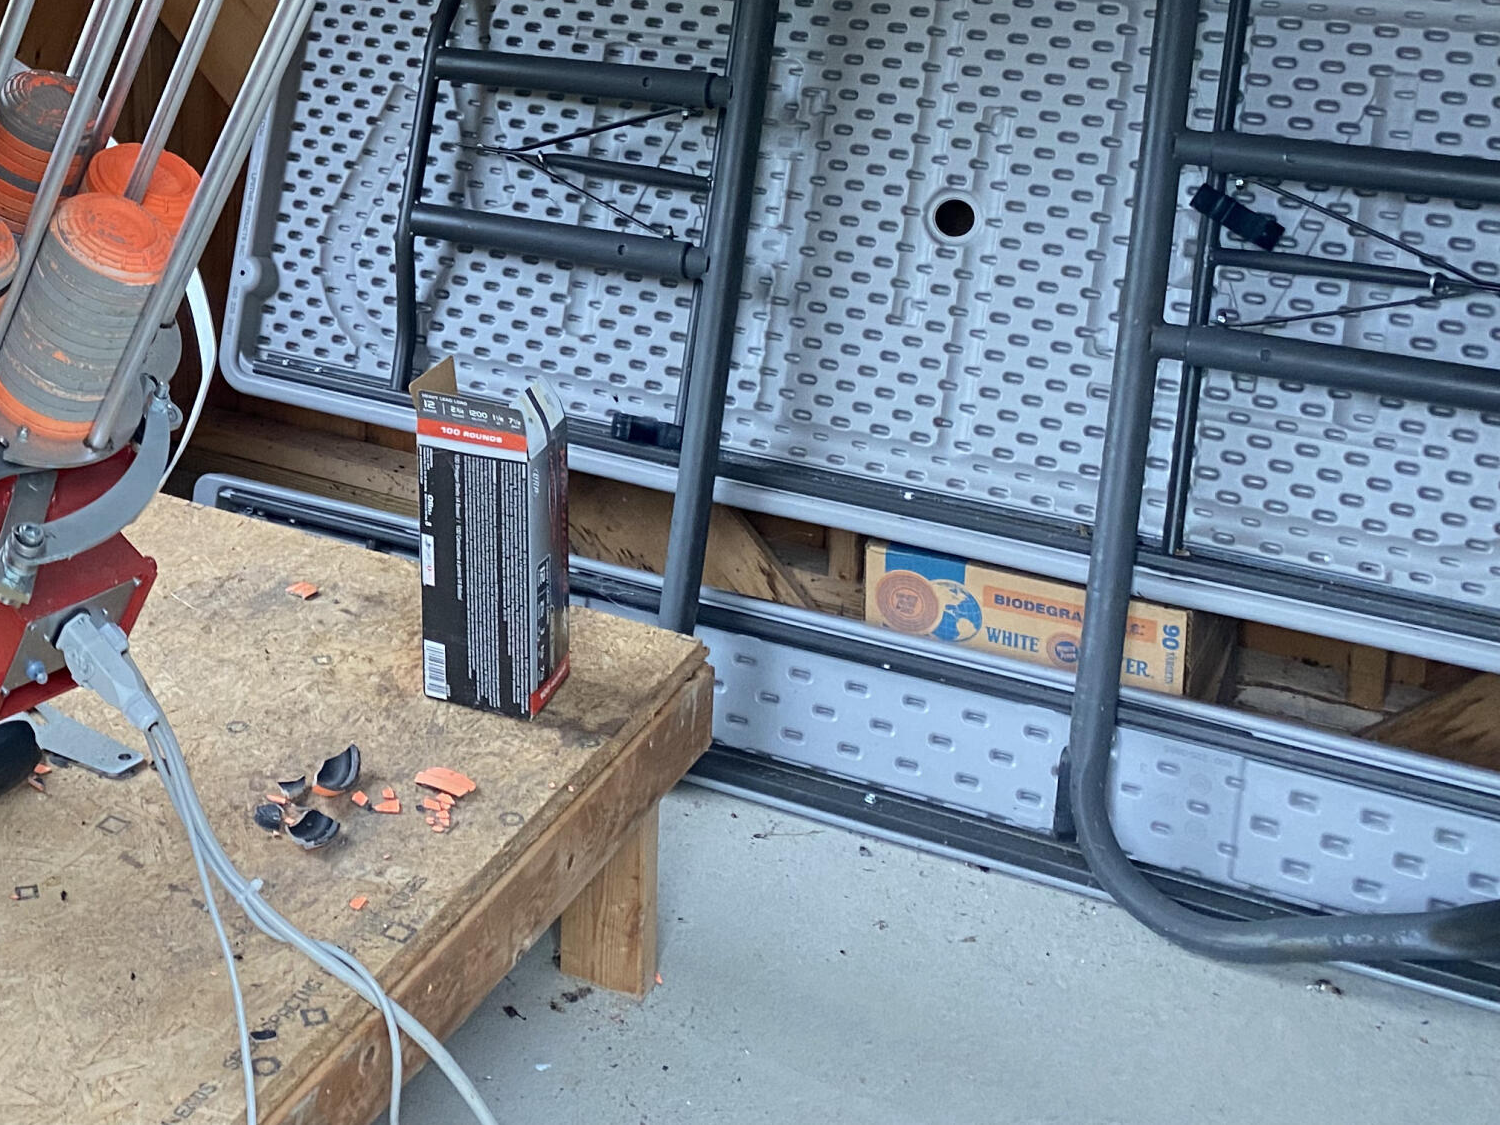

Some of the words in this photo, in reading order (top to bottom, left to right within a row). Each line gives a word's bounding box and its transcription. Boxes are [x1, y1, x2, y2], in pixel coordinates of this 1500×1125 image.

[423, 399, 436, 409] 12
[468, 409, 488, 420] 1200
[441, 426, 461, 436] 100
[463, 431, 503, 444] ROUNDS
[986, 626, 1040, 653] WHITE
[1161, 624, 1181, 651] 90
